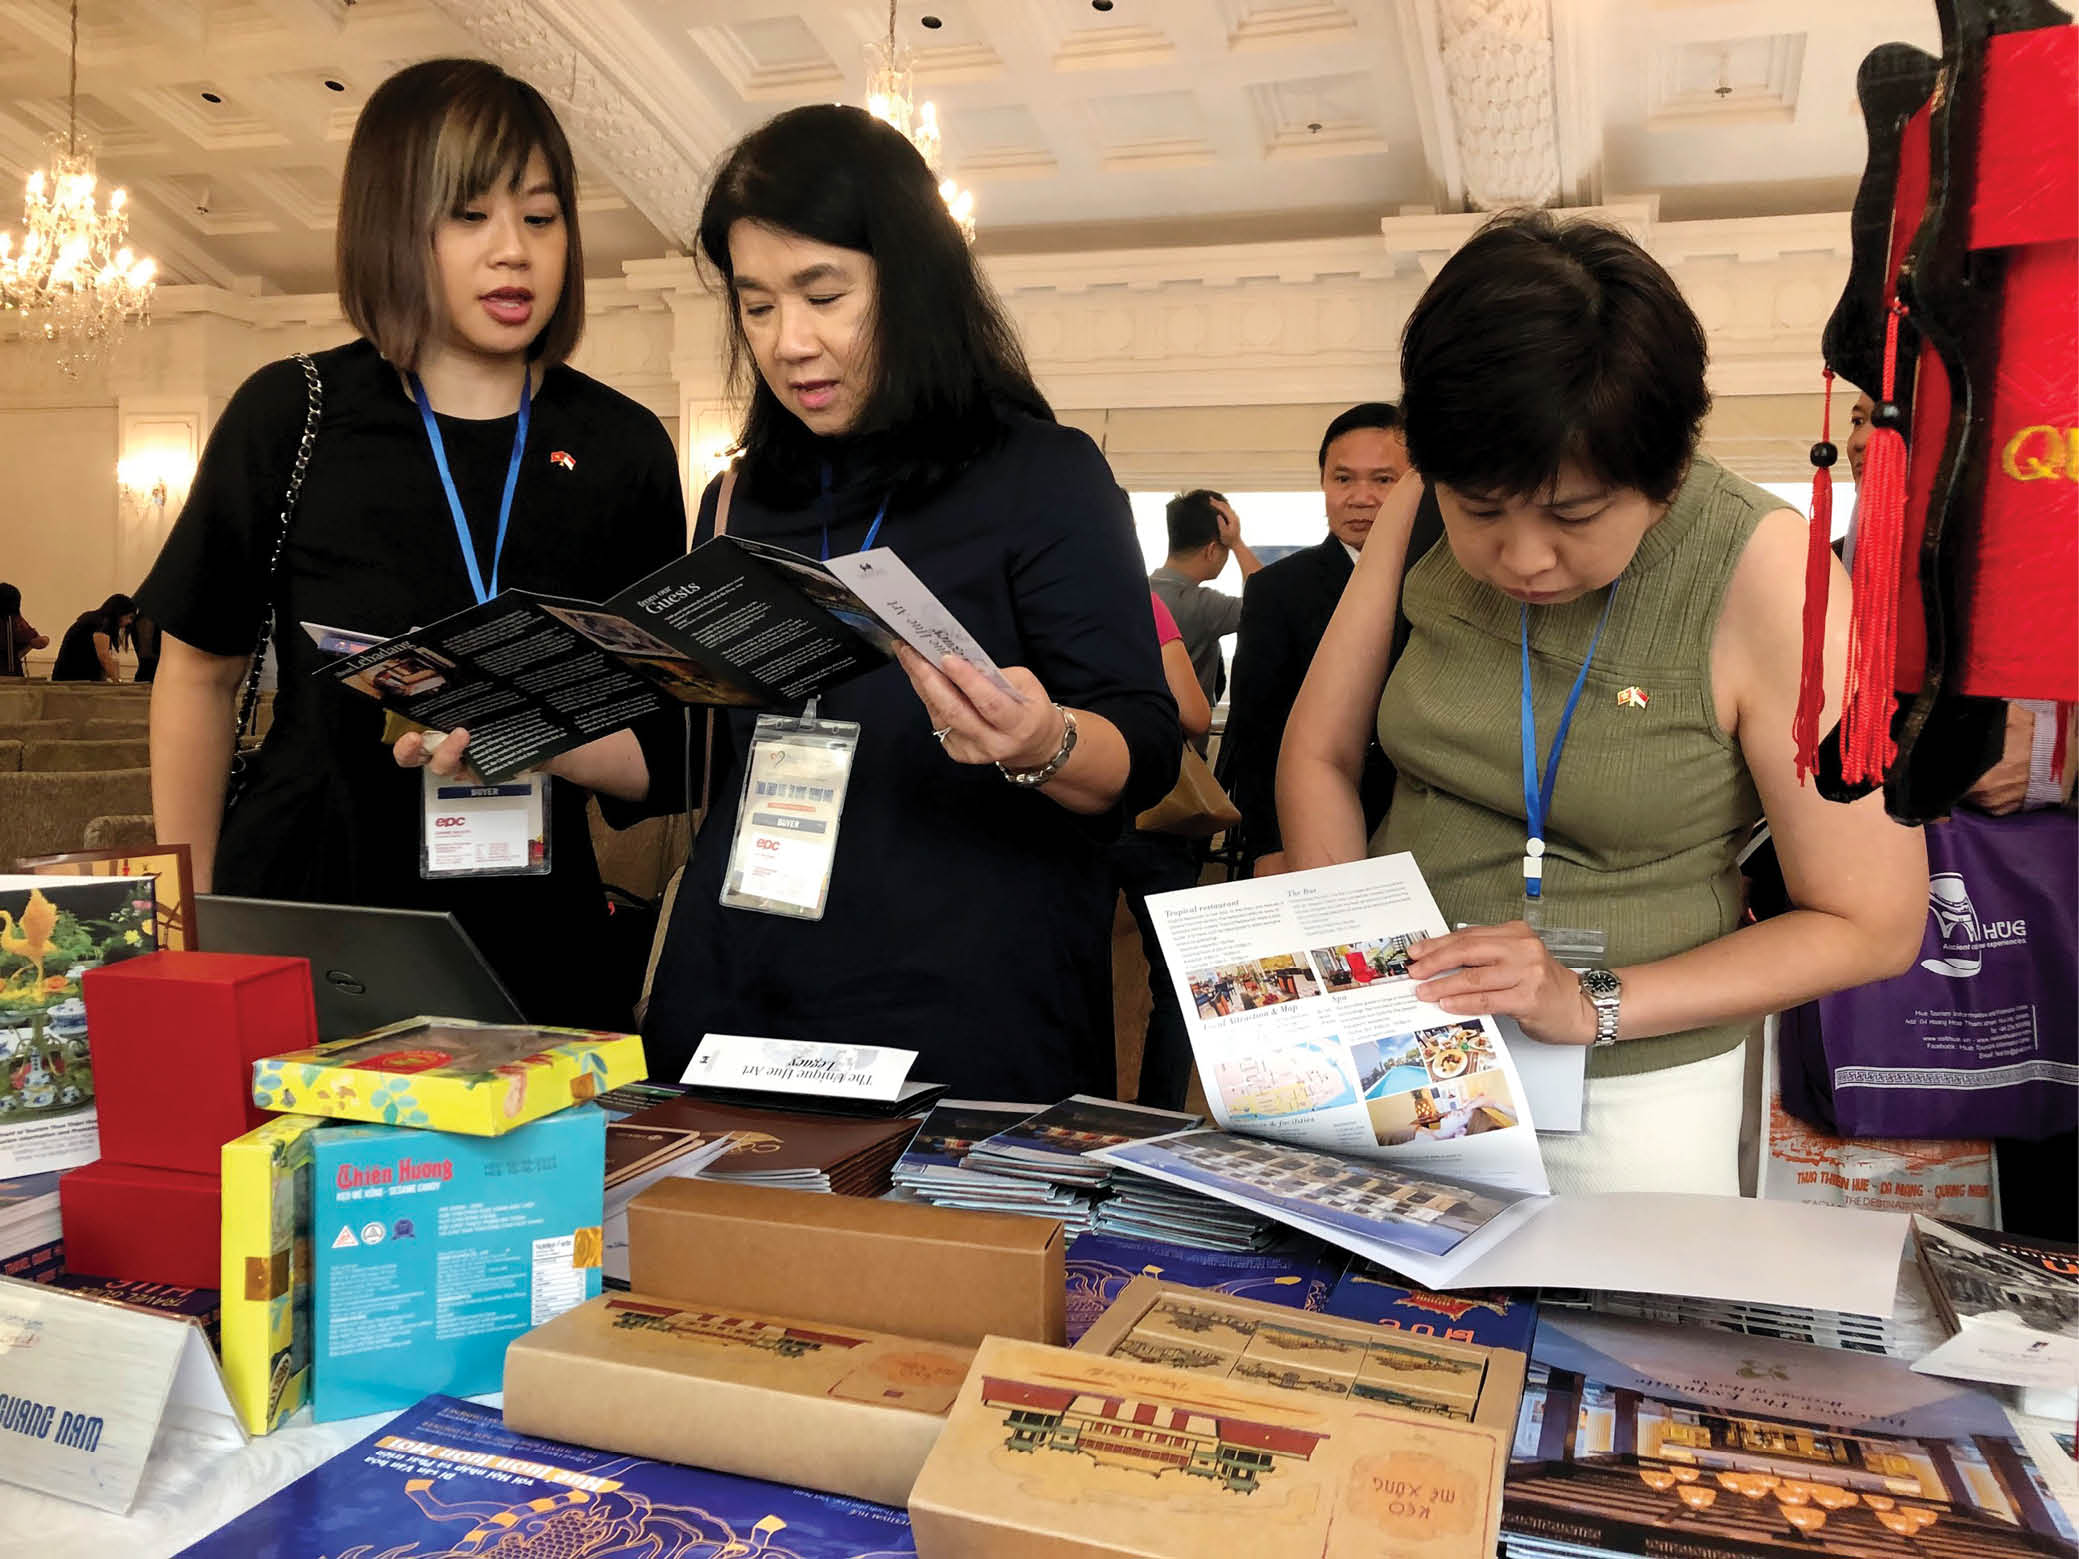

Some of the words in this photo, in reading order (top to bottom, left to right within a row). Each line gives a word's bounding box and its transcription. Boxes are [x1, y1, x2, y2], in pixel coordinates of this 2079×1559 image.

[2002, 425, 2079, 484] Q
[646, 583, 700, 614] Guests
[471, 787, 499, 797] BUYER
[435, 816, 466, 828] epc
[776, 817, 800, 829] BUYER
[756, 837, 780, 851] epc
[1164, 905, 1198, 918] Tropical
[1199, 899, 1240, 912] restaurant
[1982, 919, 2027, 940] HUE
[742, 1065, 761, 1076] Art
[787, 1057, 837, 1071] Legacy
[766, 1067, 794, 1080] Hue
[797, 1069, 848, 1085] Unique
[847, 1072, 873, 1086] The
[54, 1410, 104, 1452] NAM
